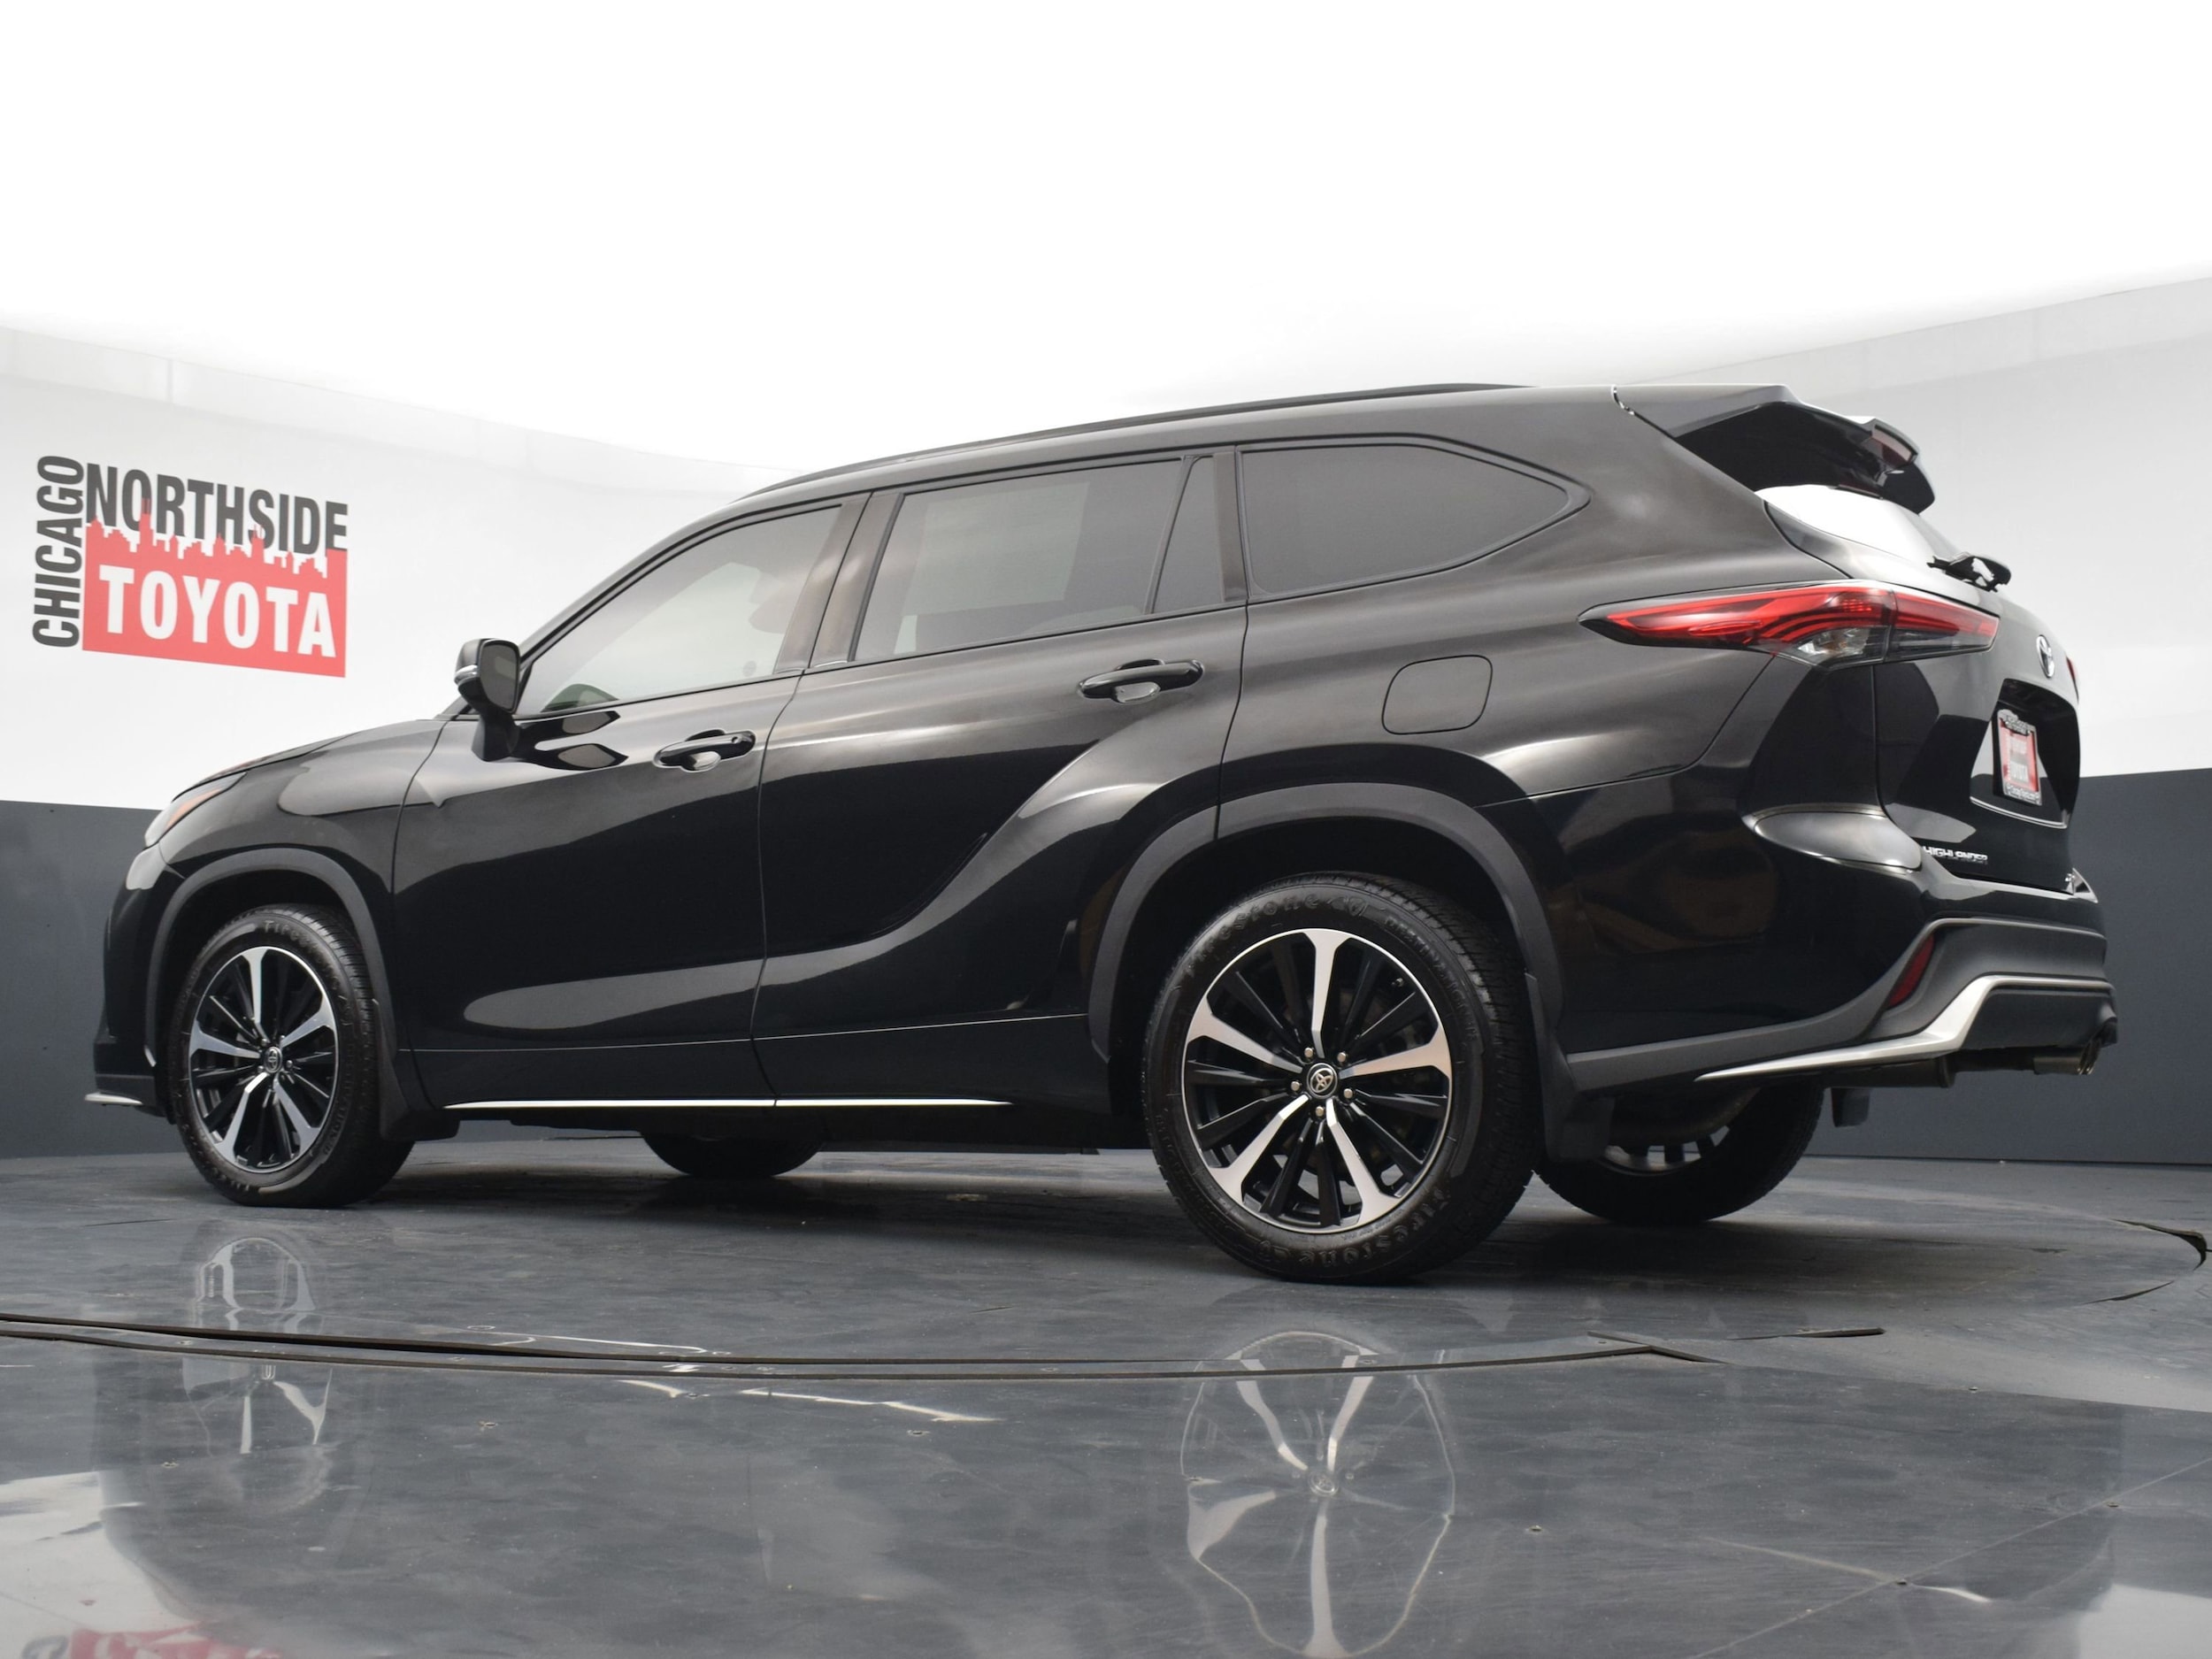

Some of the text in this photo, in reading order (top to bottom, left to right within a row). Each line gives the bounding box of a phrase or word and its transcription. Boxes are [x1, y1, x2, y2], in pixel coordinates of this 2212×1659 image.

[32, 455, 84, 648] CHICAGO
[86, 462, 349, 556] NORTHSIDE
[98, 564, 337, 658] TOYOTA
